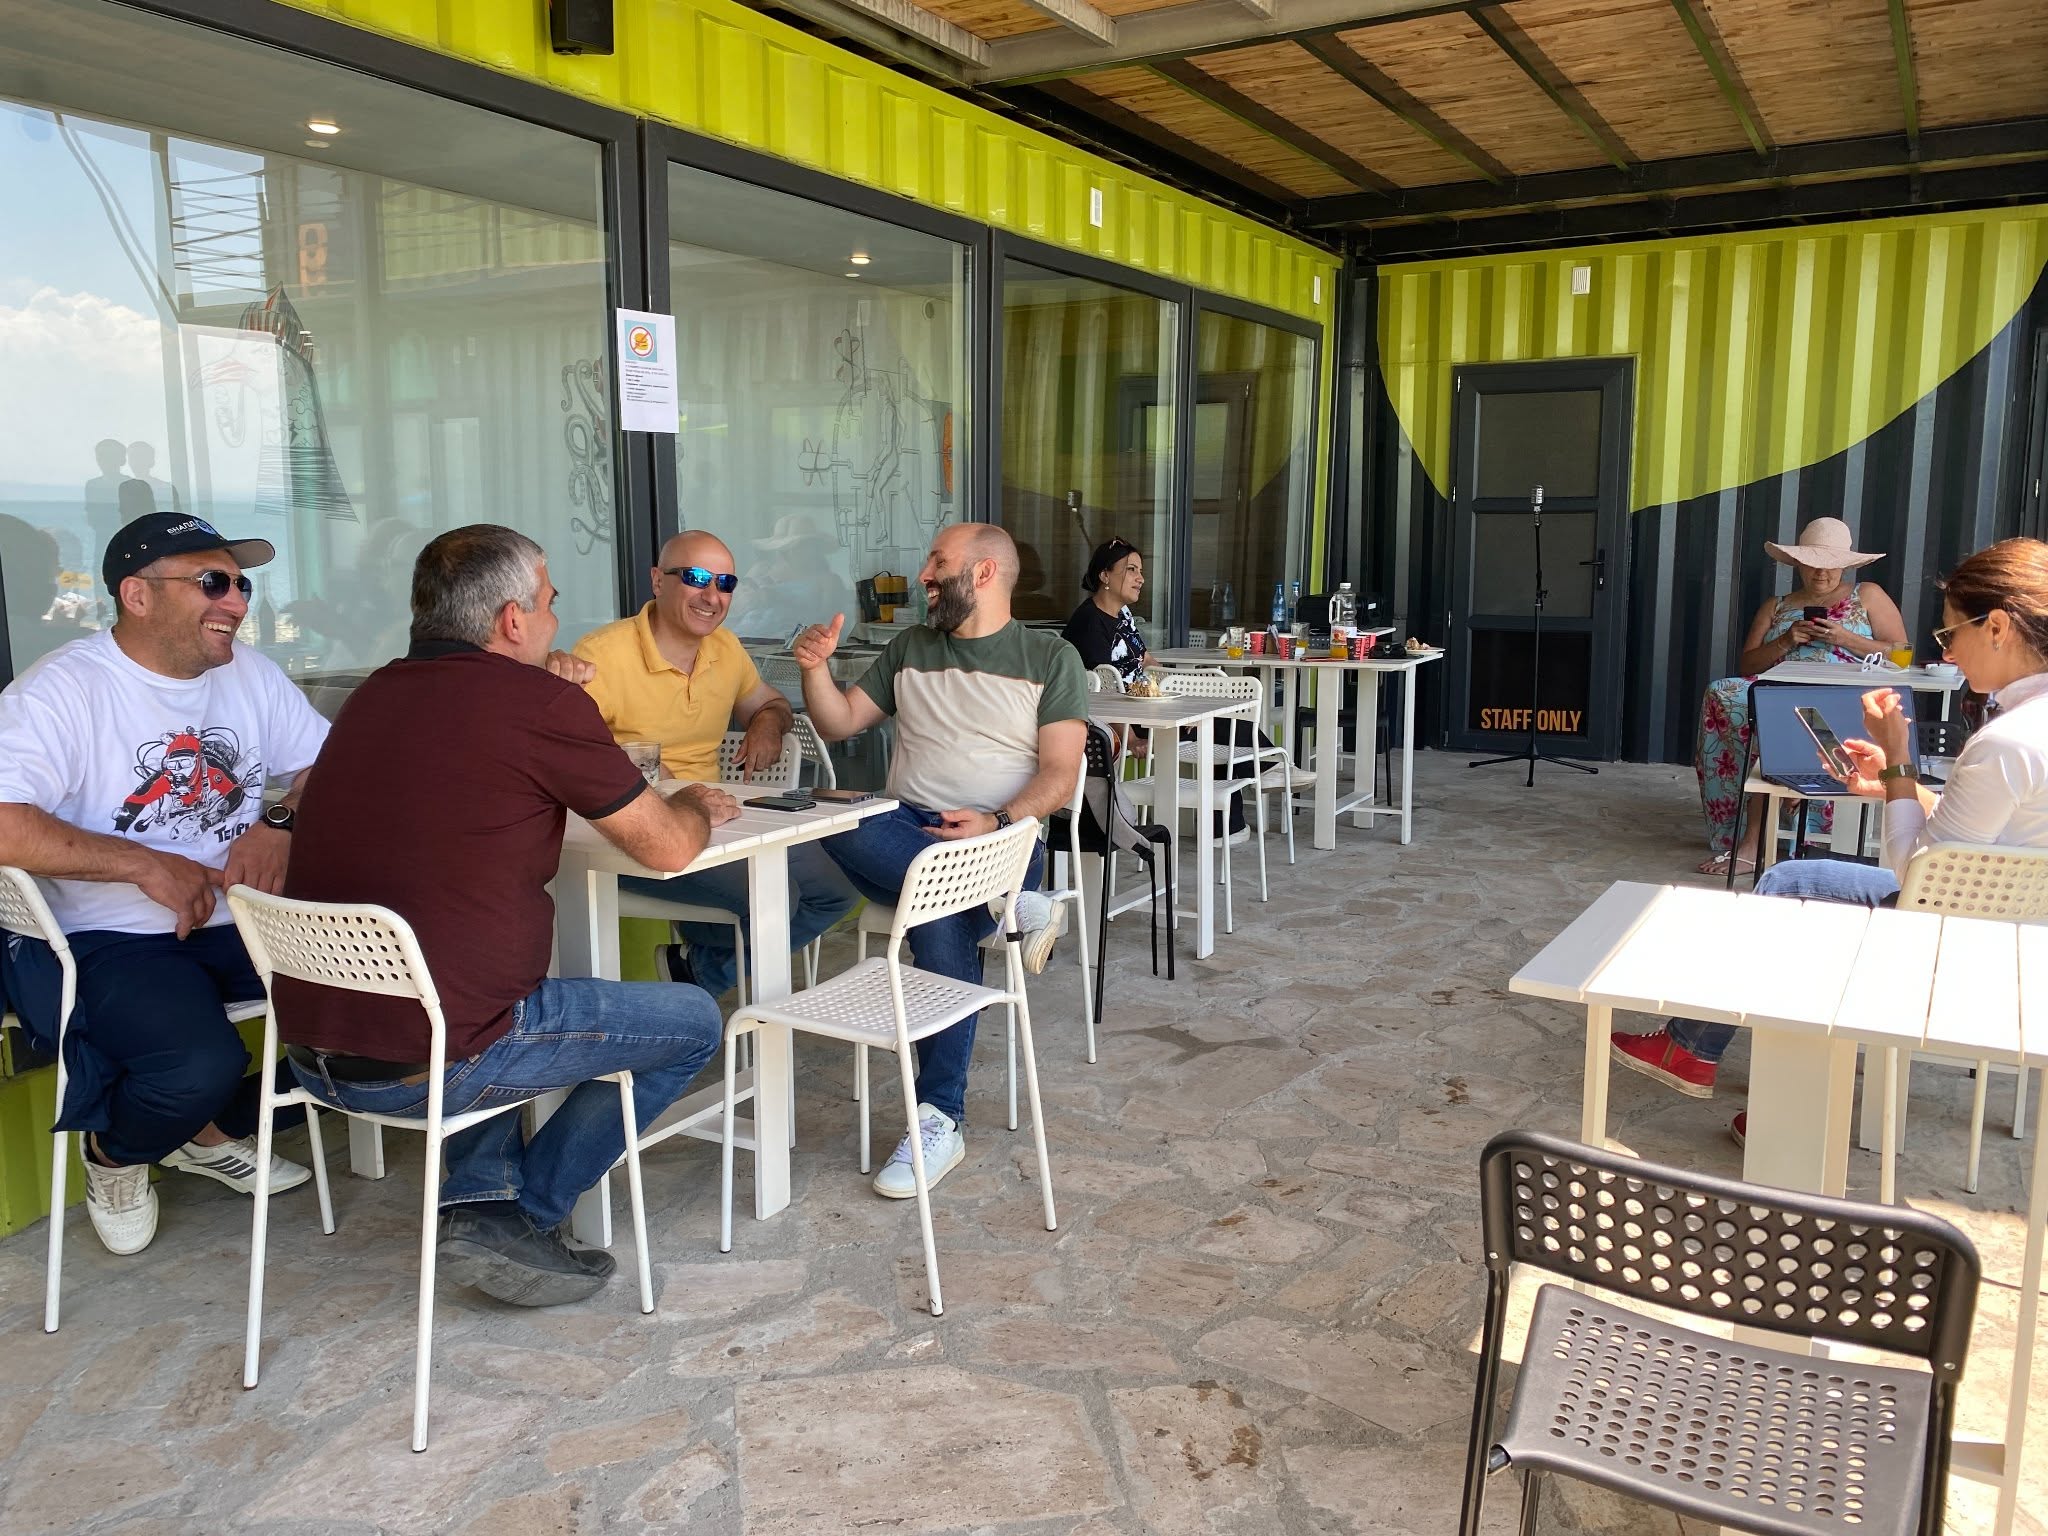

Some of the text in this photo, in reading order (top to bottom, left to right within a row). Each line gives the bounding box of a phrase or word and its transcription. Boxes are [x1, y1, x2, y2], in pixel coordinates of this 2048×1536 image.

[1353, 638, 1361, 657] fresh
[1481, 708, 1582, 732] STAFF ONLY
